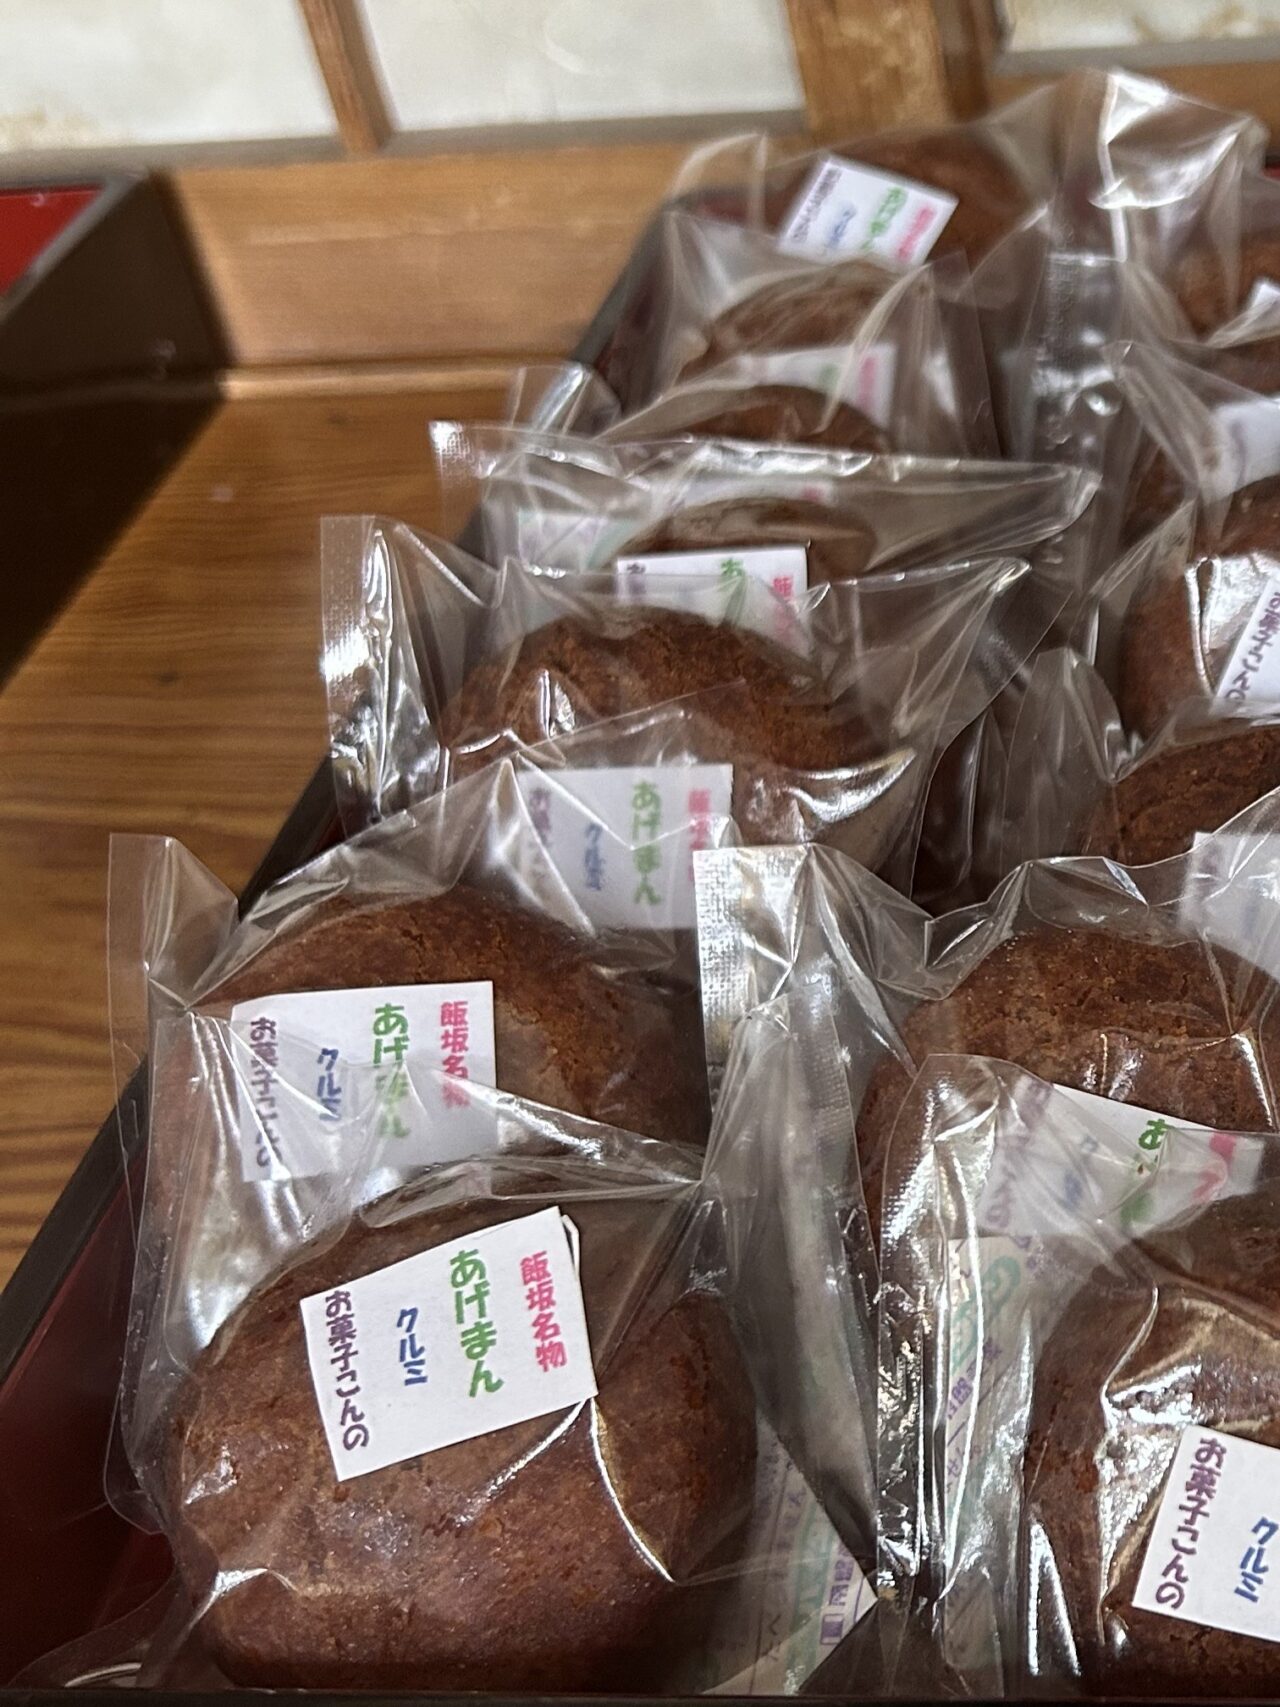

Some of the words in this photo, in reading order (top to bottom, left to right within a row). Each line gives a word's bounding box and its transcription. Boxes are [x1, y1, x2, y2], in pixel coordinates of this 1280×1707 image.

[325, 1290, 370, 1451] お菓子こんの
[396, 1307, 429, 1386] クルミ
[450, 1249, 504, 1398] あげまん
[520, 1251, 568, 1373] 飯坂名物
[1155, 1436, 1228, 1609] お菓子こんの
[1233, 1516, 1280, 1603] クルミ
